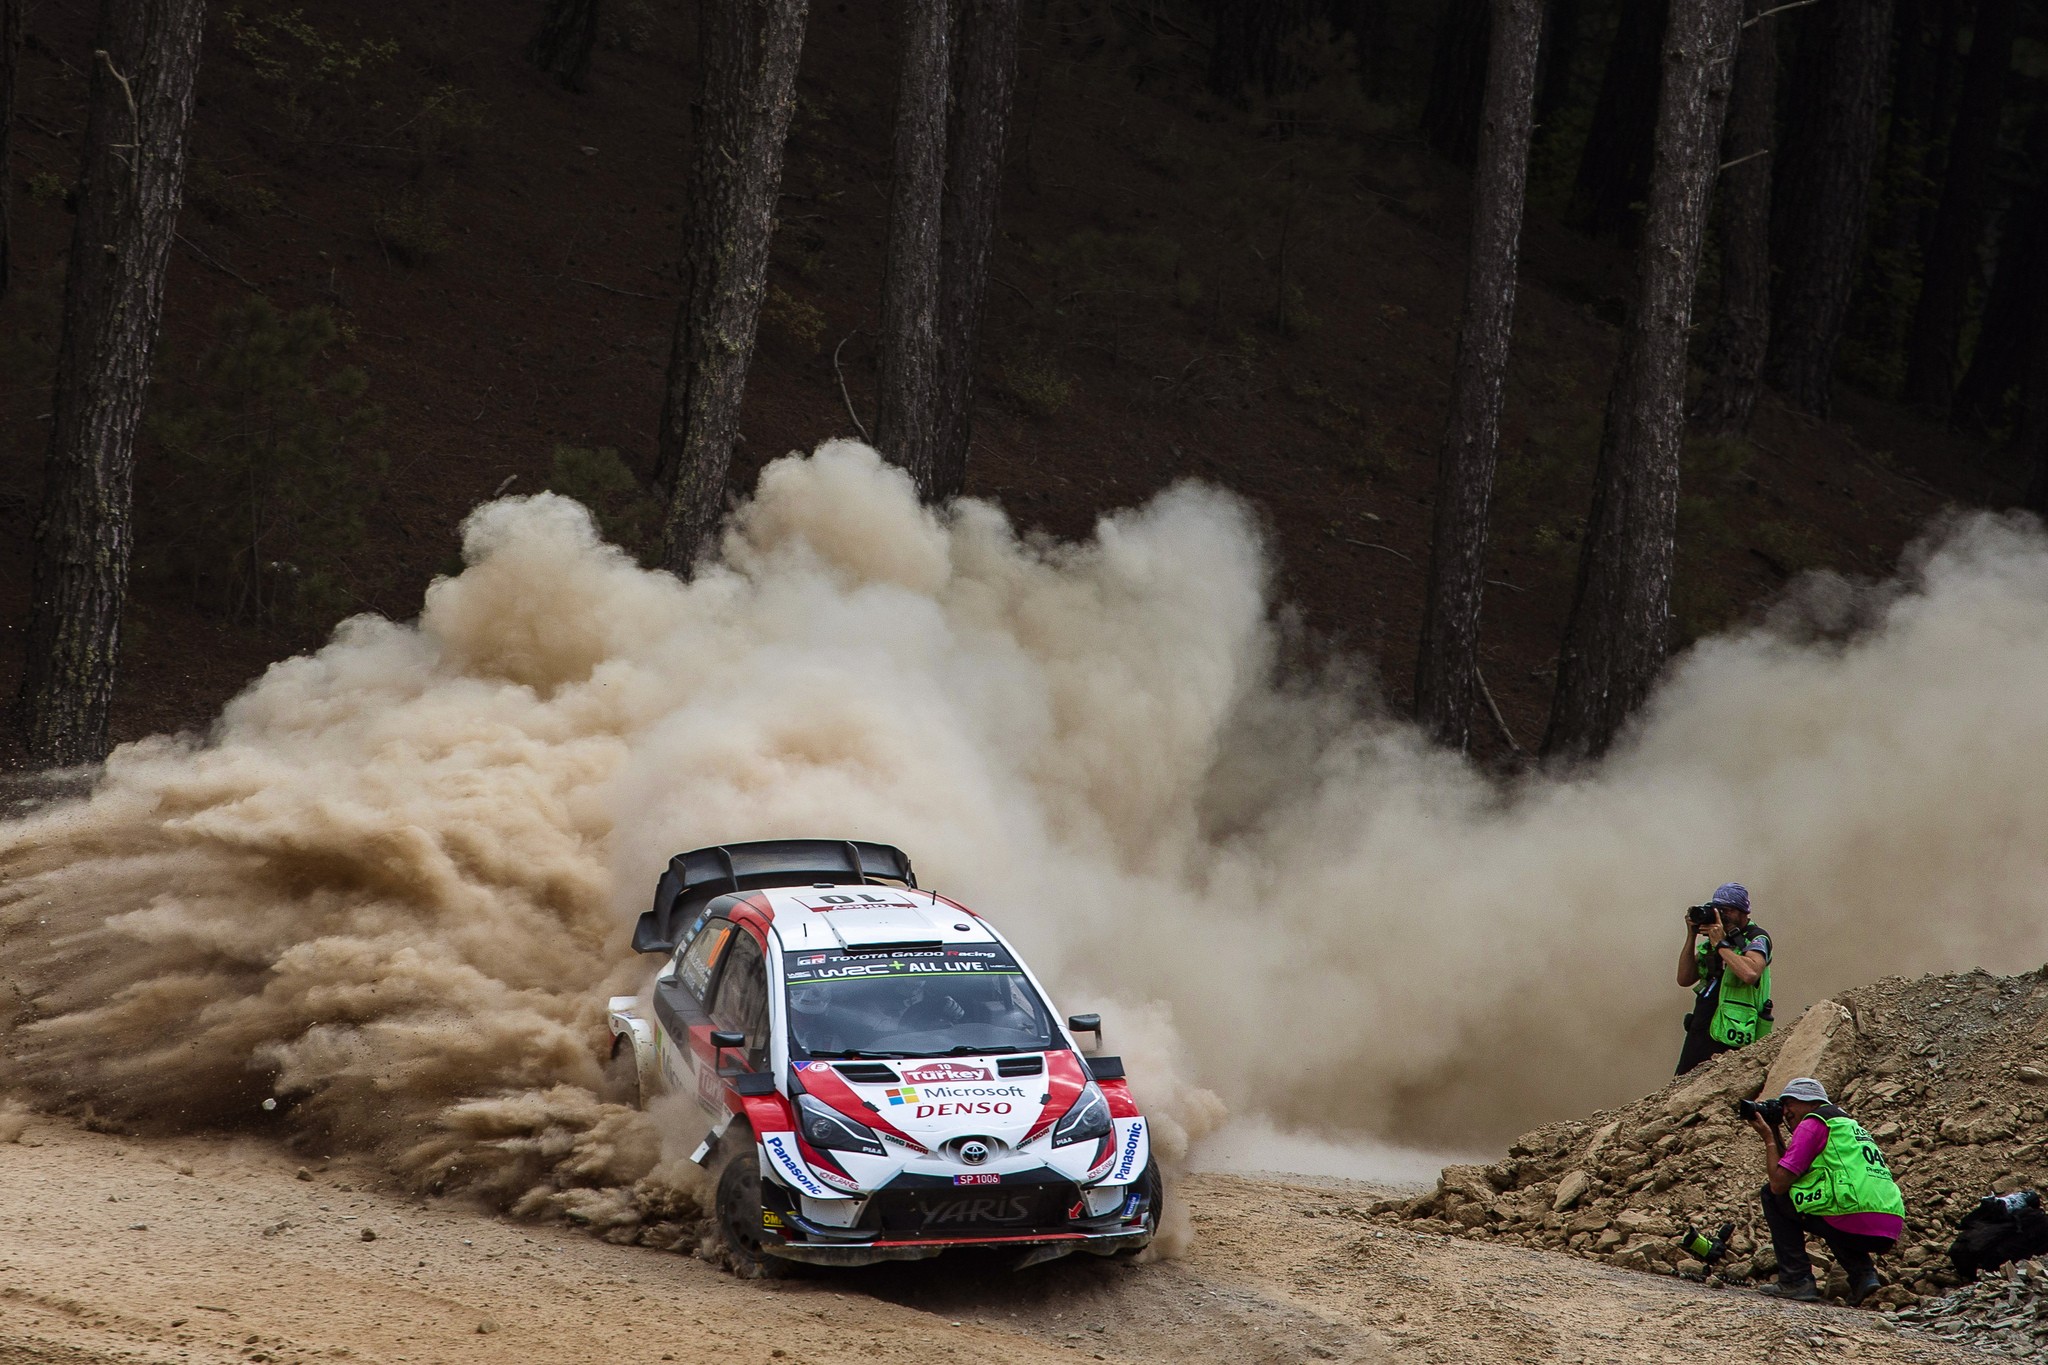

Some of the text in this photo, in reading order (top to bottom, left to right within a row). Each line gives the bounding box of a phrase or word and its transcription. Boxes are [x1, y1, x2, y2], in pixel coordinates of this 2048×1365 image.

[829, 952, 888, 962] TOYOTA
[947, 950, 996, 958] Racing
[909, 962, 942, 973] ALL
[944, 961, 984, 971] LIVE
[1727, 1028, 1752, 1045] 033
[906, 1068, 986, 1081] Turkey
[924, 1086, 1025, 1099] Microsoft
[916, 1102, 1012, 1119] DENSO
[885, 1134, 929, 1155] DMG MORI
[1016, 1127, 1050, 1151] DMG MORI
[1056, 1137, 1073, 1146] PIAA
[862, 1146, 882, 1155] PIAA
[1114, 1122, 1142, 1181] Panasonic
[767, 1136, 822, 1196] Panasonic
[960, 1174, 999, 1185] SP 1006
[1795, 1189, 1822, 1206] 048
